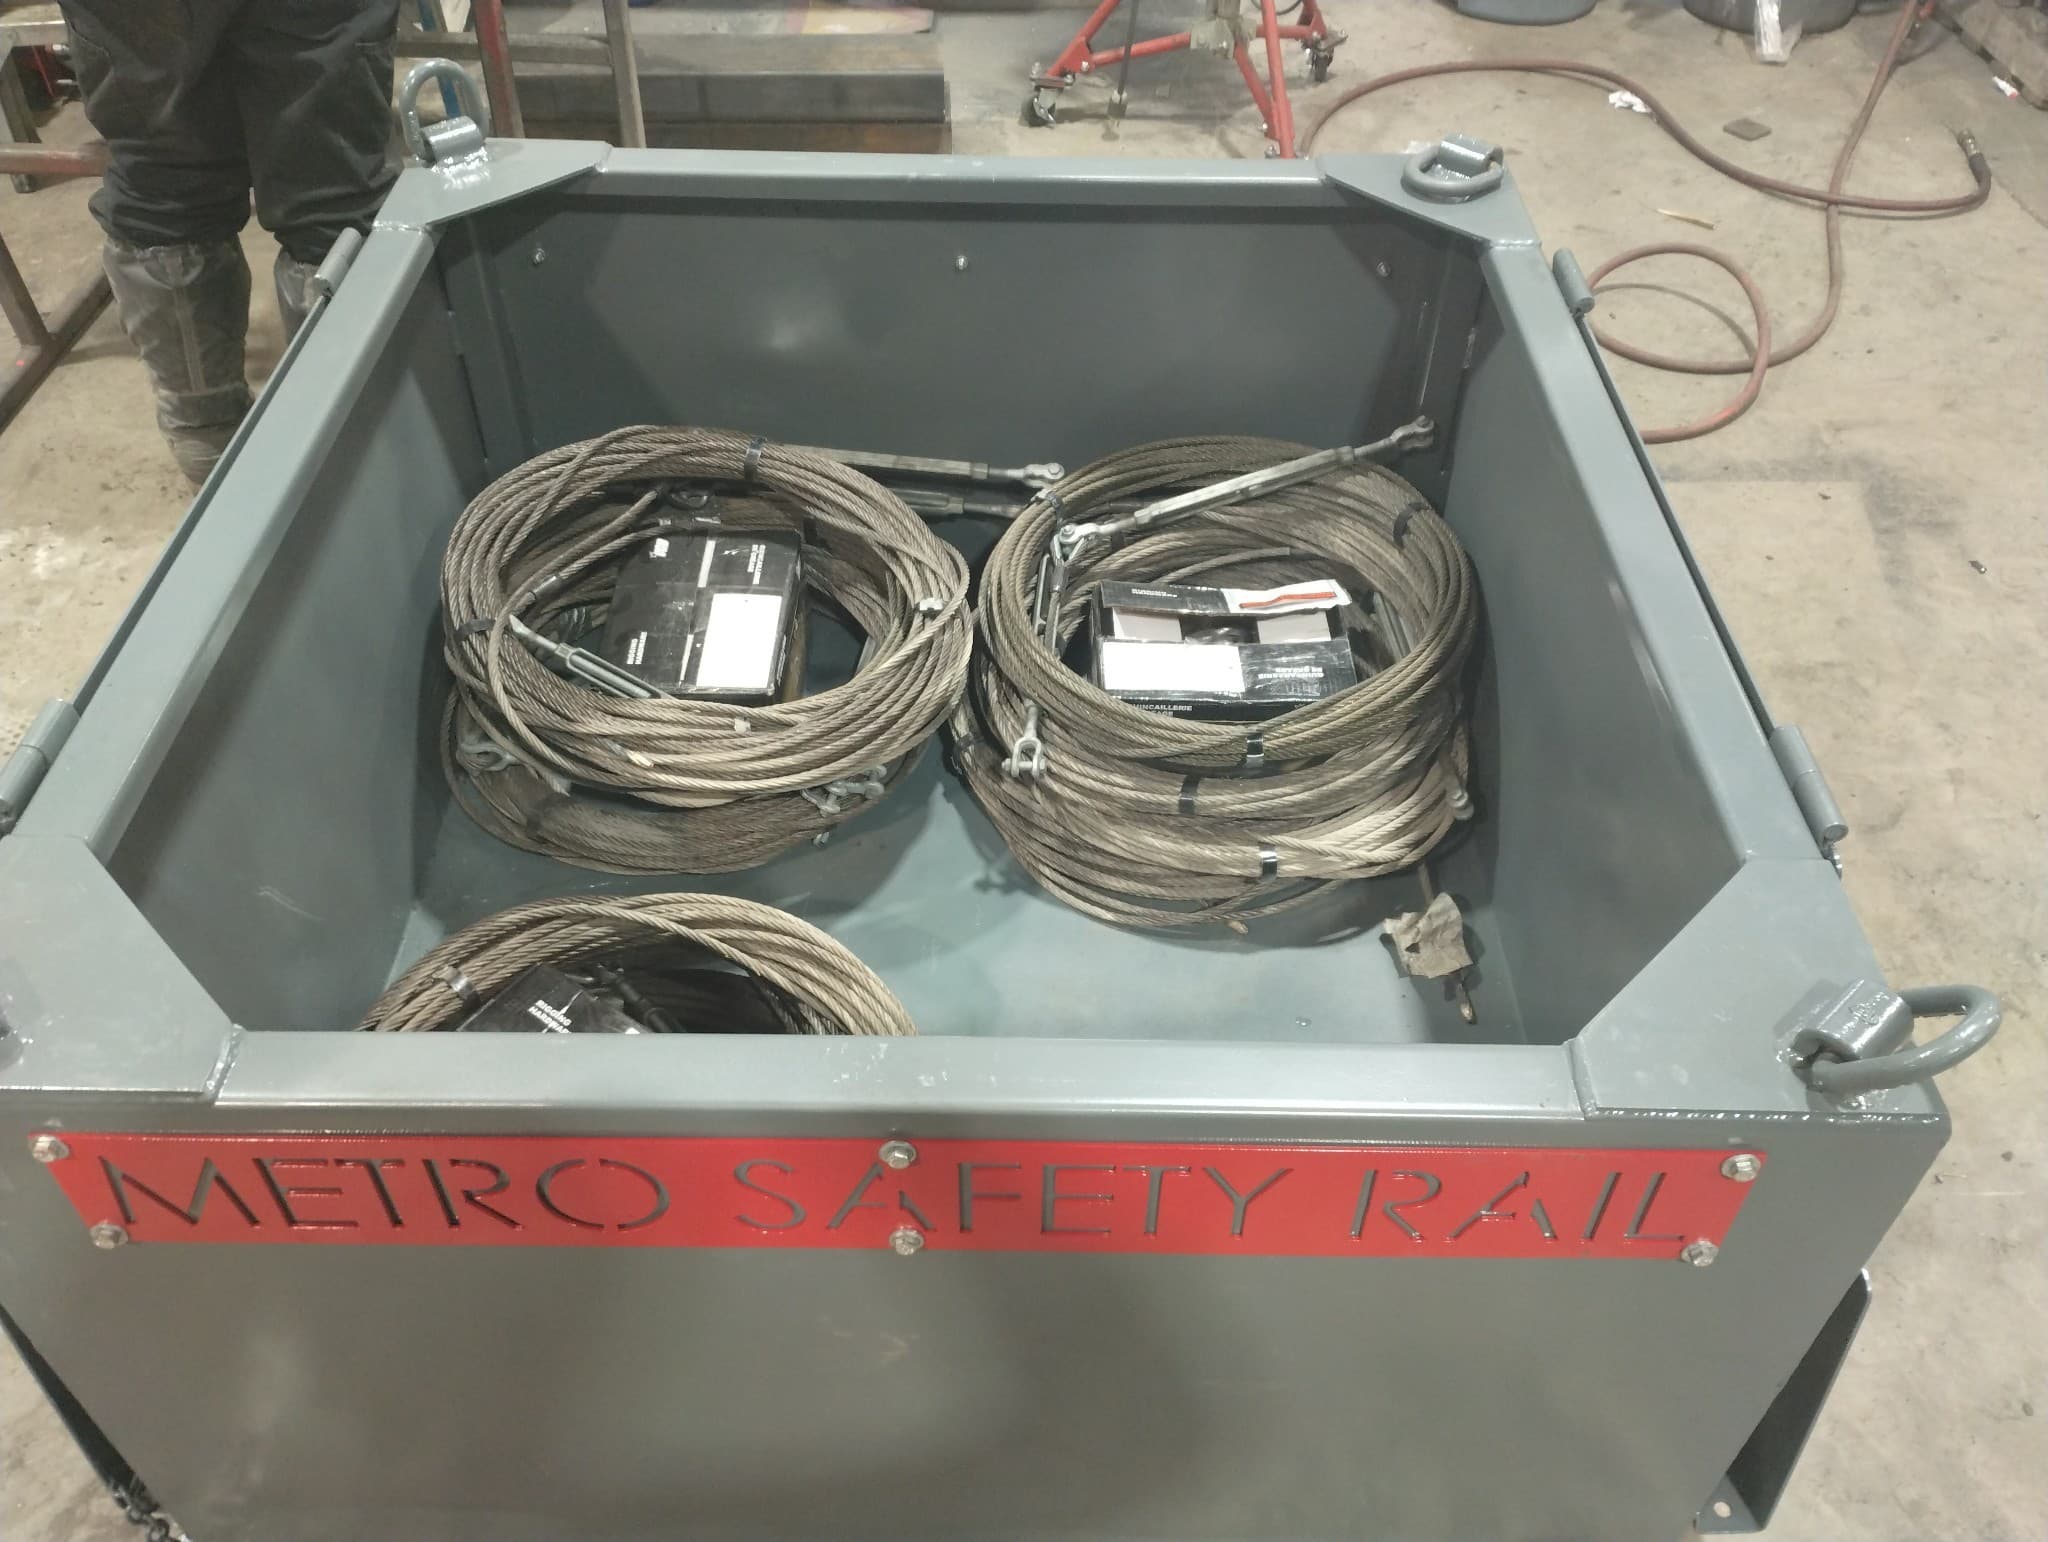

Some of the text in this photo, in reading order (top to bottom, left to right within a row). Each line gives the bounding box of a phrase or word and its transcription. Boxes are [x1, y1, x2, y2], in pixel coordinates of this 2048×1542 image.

[536, 999, 572, 1026] RIGGING
[98, 1156, 1687, 1243] METRO SAFETY RAIL
